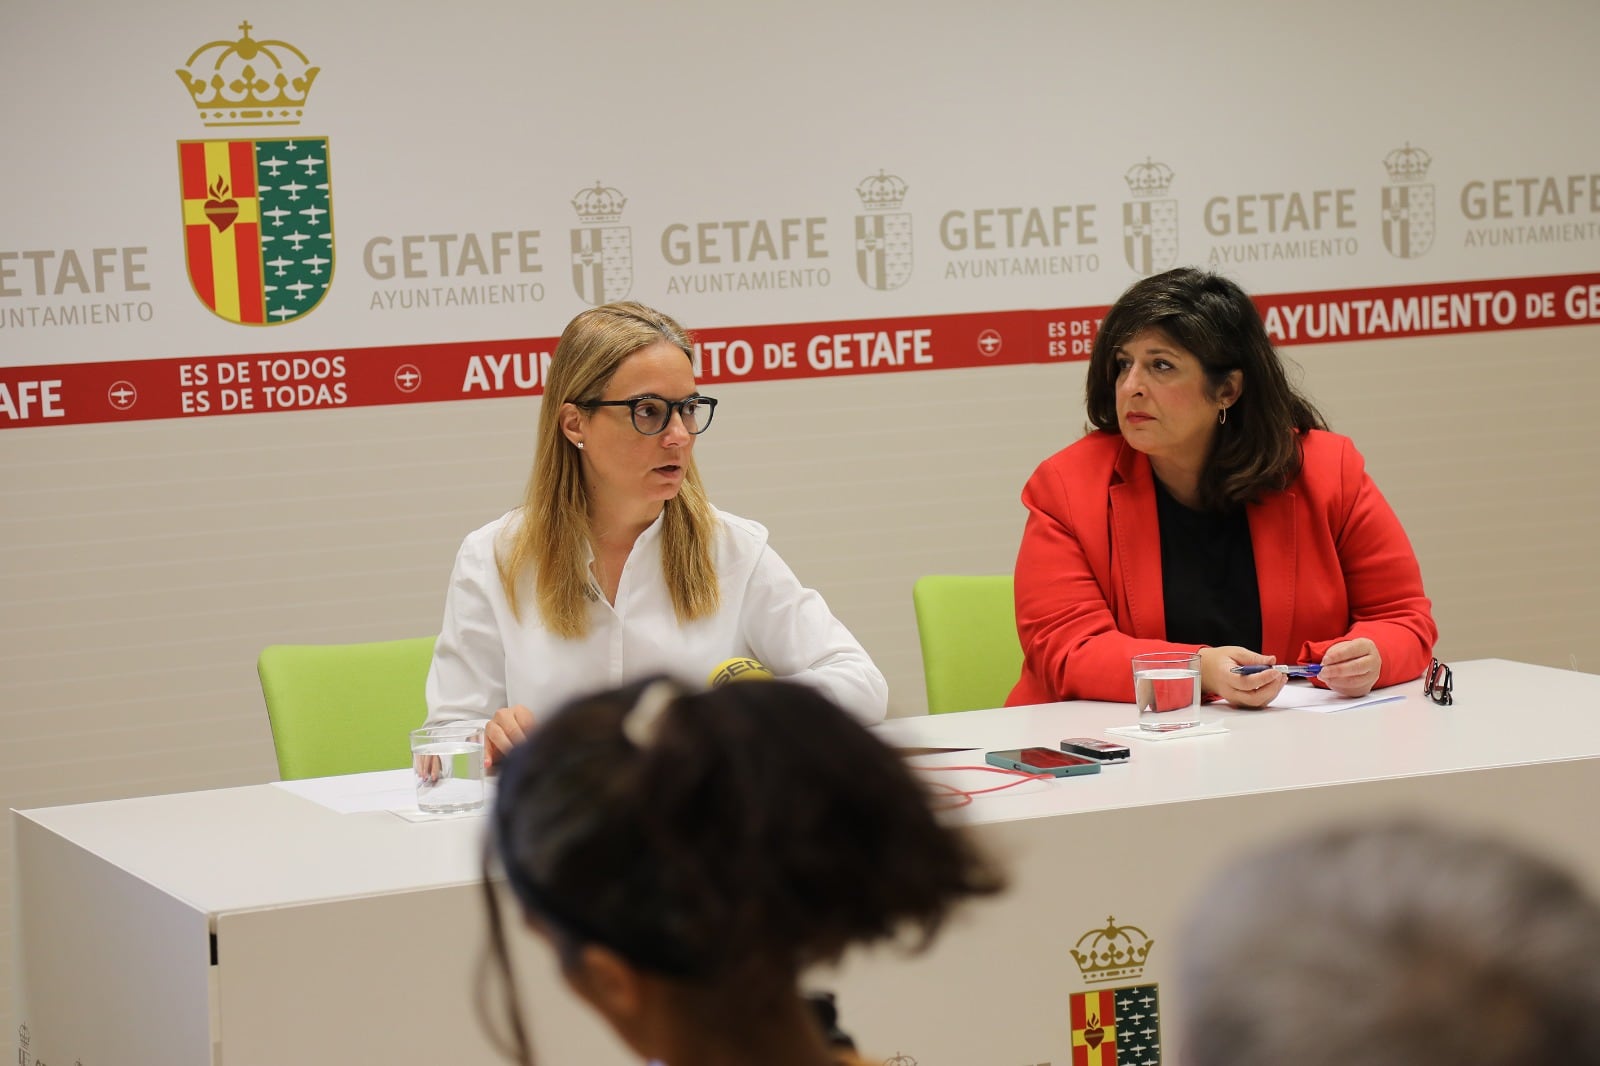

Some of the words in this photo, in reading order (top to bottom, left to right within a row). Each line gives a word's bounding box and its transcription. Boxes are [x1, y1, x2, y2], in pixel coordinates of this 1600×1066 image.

[1204, 188, 1357, 236] GETAFE
[661, 217, 828, 266] GETAFE
[939, 204, 1098, 251] GETAFE
[1464, 221, 1600, 247] AYUNTAMIENT
[363, 230, 543, 280] GETAFE
[1208, 237, 1359, 263] AYUNTAMIENTO
[667, 268, 830, 294] AYUNTAMIENTO
[945, 254, 1099, 279] AYUNTAMIENTO
[370, 283, 544, 310] AYUNTAMIENTO
[1049, 322, 1066, 337] ES
[1071, 320, 1090, 336] DE
[1264, 290, 1517, 340] AYUNTAMIENTO
[1526, 293, 1555, 318] DE
[764, 342, 797, 369] DE
[807, 329, 933, 371] GETAFE
[1049, 341, 1066, 356] ES
[1072, 339, 1091, 354] DE
[180, 364, 208, 386] ES
[218, 362, 250, 384] DE
[258, 356, 346, 382] TODOS
[182, 391, 210, 413] ES
[221, 388, 253, 410] DE
[262, 383, 348, 408] TODAS
